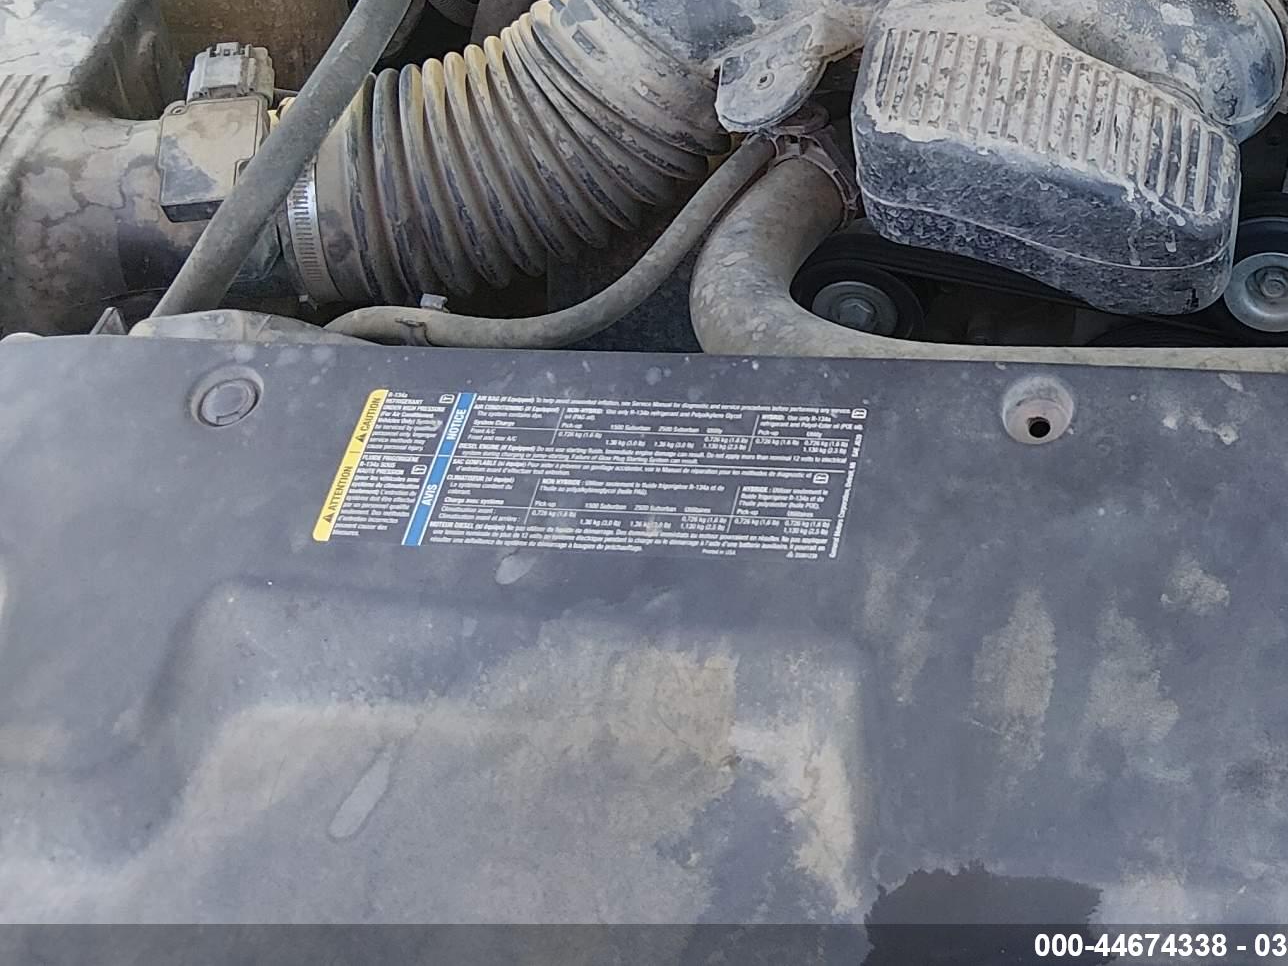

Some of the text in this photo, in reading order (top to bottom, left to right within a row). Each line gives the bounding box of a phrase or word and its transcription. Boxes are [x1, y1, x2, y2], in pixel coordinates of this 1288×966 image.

[360, 397, 382, 432] CAUTION
[446, 409, 467, 441] NOTICE
[330, 465, 353, 512] ATTENTION
[421, 483, 439, 507] AVIS
